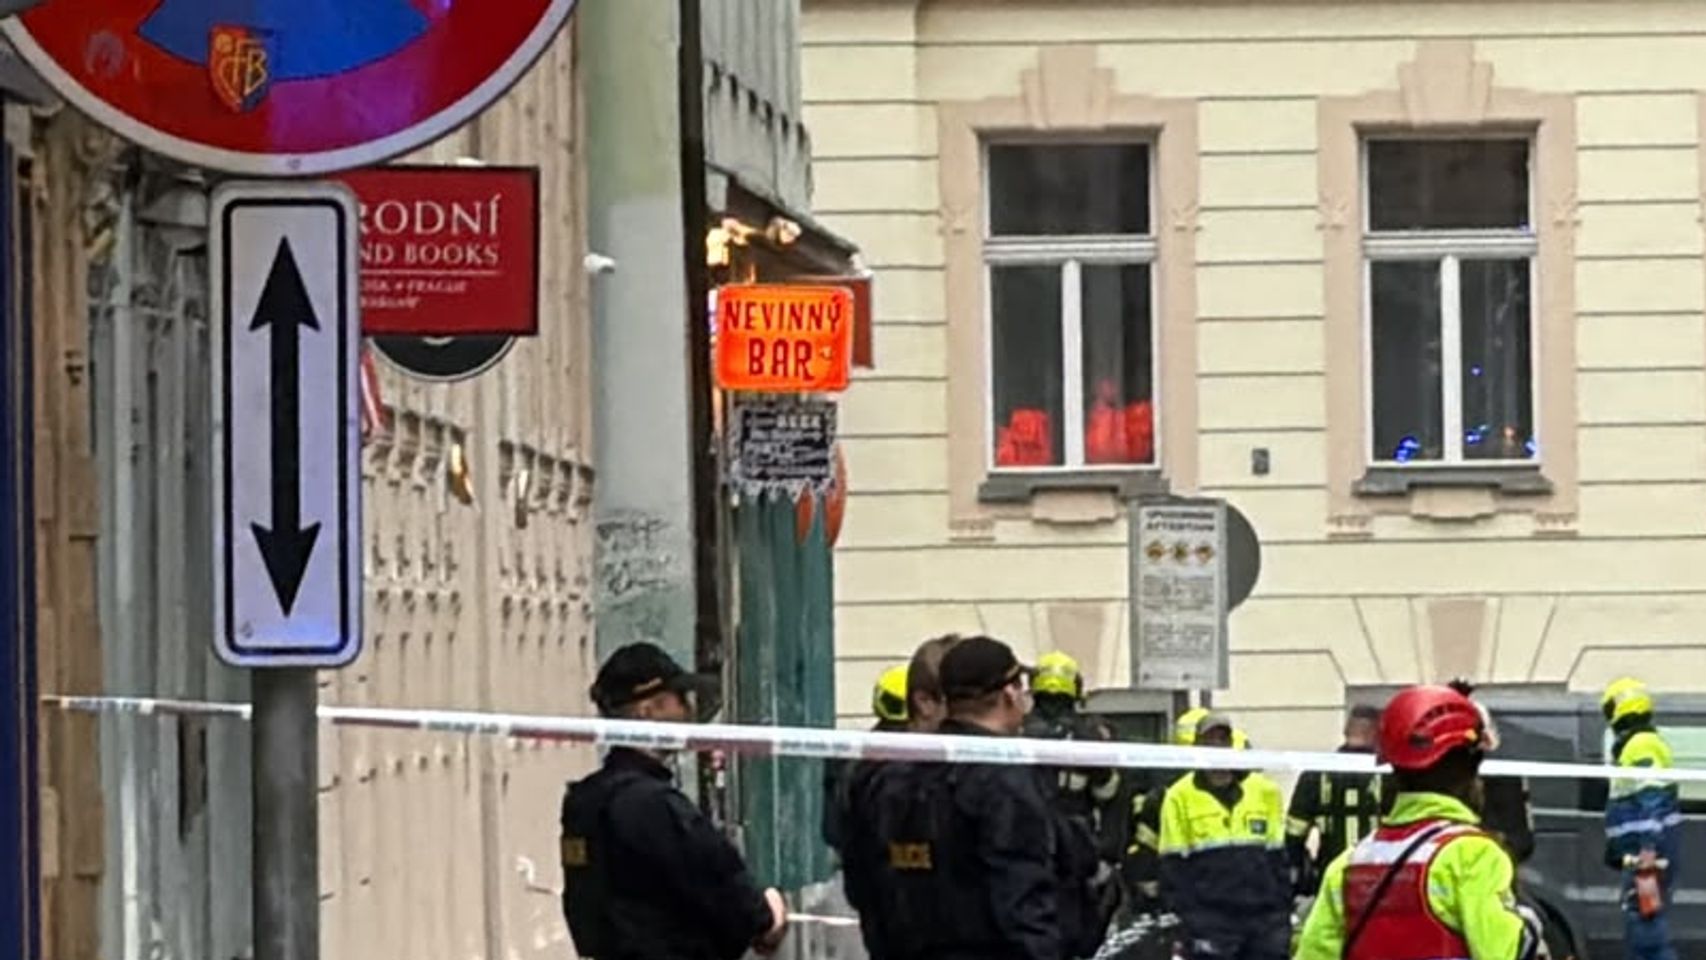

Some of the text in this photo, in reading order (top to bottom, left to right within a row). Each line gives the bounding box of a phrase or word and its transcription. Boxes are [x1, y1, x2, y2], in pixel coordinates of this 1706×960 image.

[404, 242, 499, 266] BOOKS
[723, 296, 842, 332] NEVINNÝ
[749, 337, 814, 381] BAR
